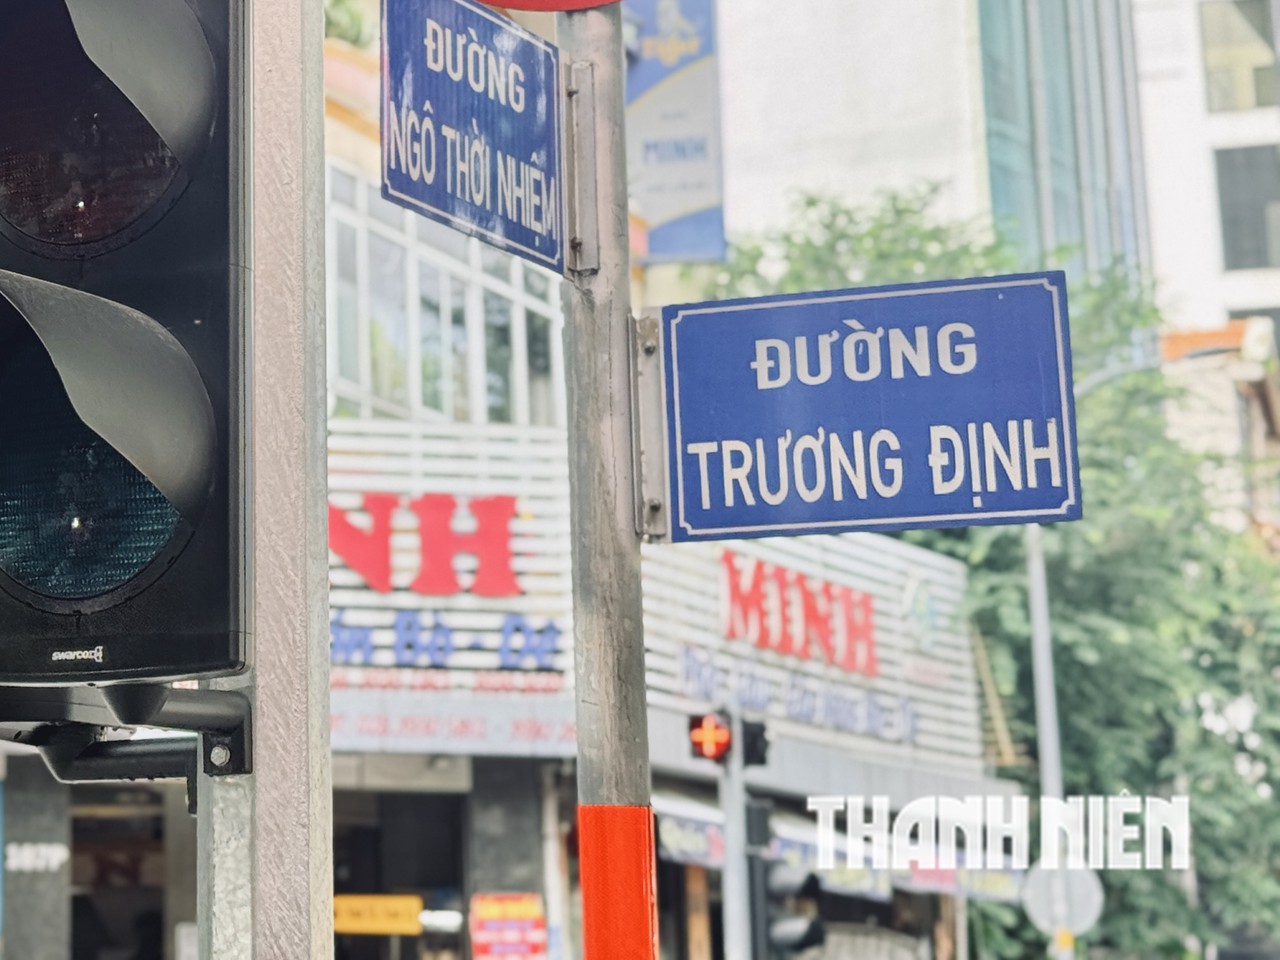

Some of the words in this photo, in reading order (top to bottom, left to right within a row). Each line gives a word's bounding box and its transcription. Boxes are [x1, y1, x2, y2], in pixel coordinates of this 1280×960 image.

[423, 17, 526, 114] ĐƯỜNG
[389, 101, 437, 185] NGÔ
[441, 117, 490, 207] THỜI
[496, 153, 558, 248] NHIỆM
[750, 319, 979, 391] ĐƯỜNG
[686, 427, 904, 511] TRƯƠNG
[928, 417, 1063, 508] ĐỊNH
[328, 492, 523, 598] NH
[722, 548, 881, 678] MINH
